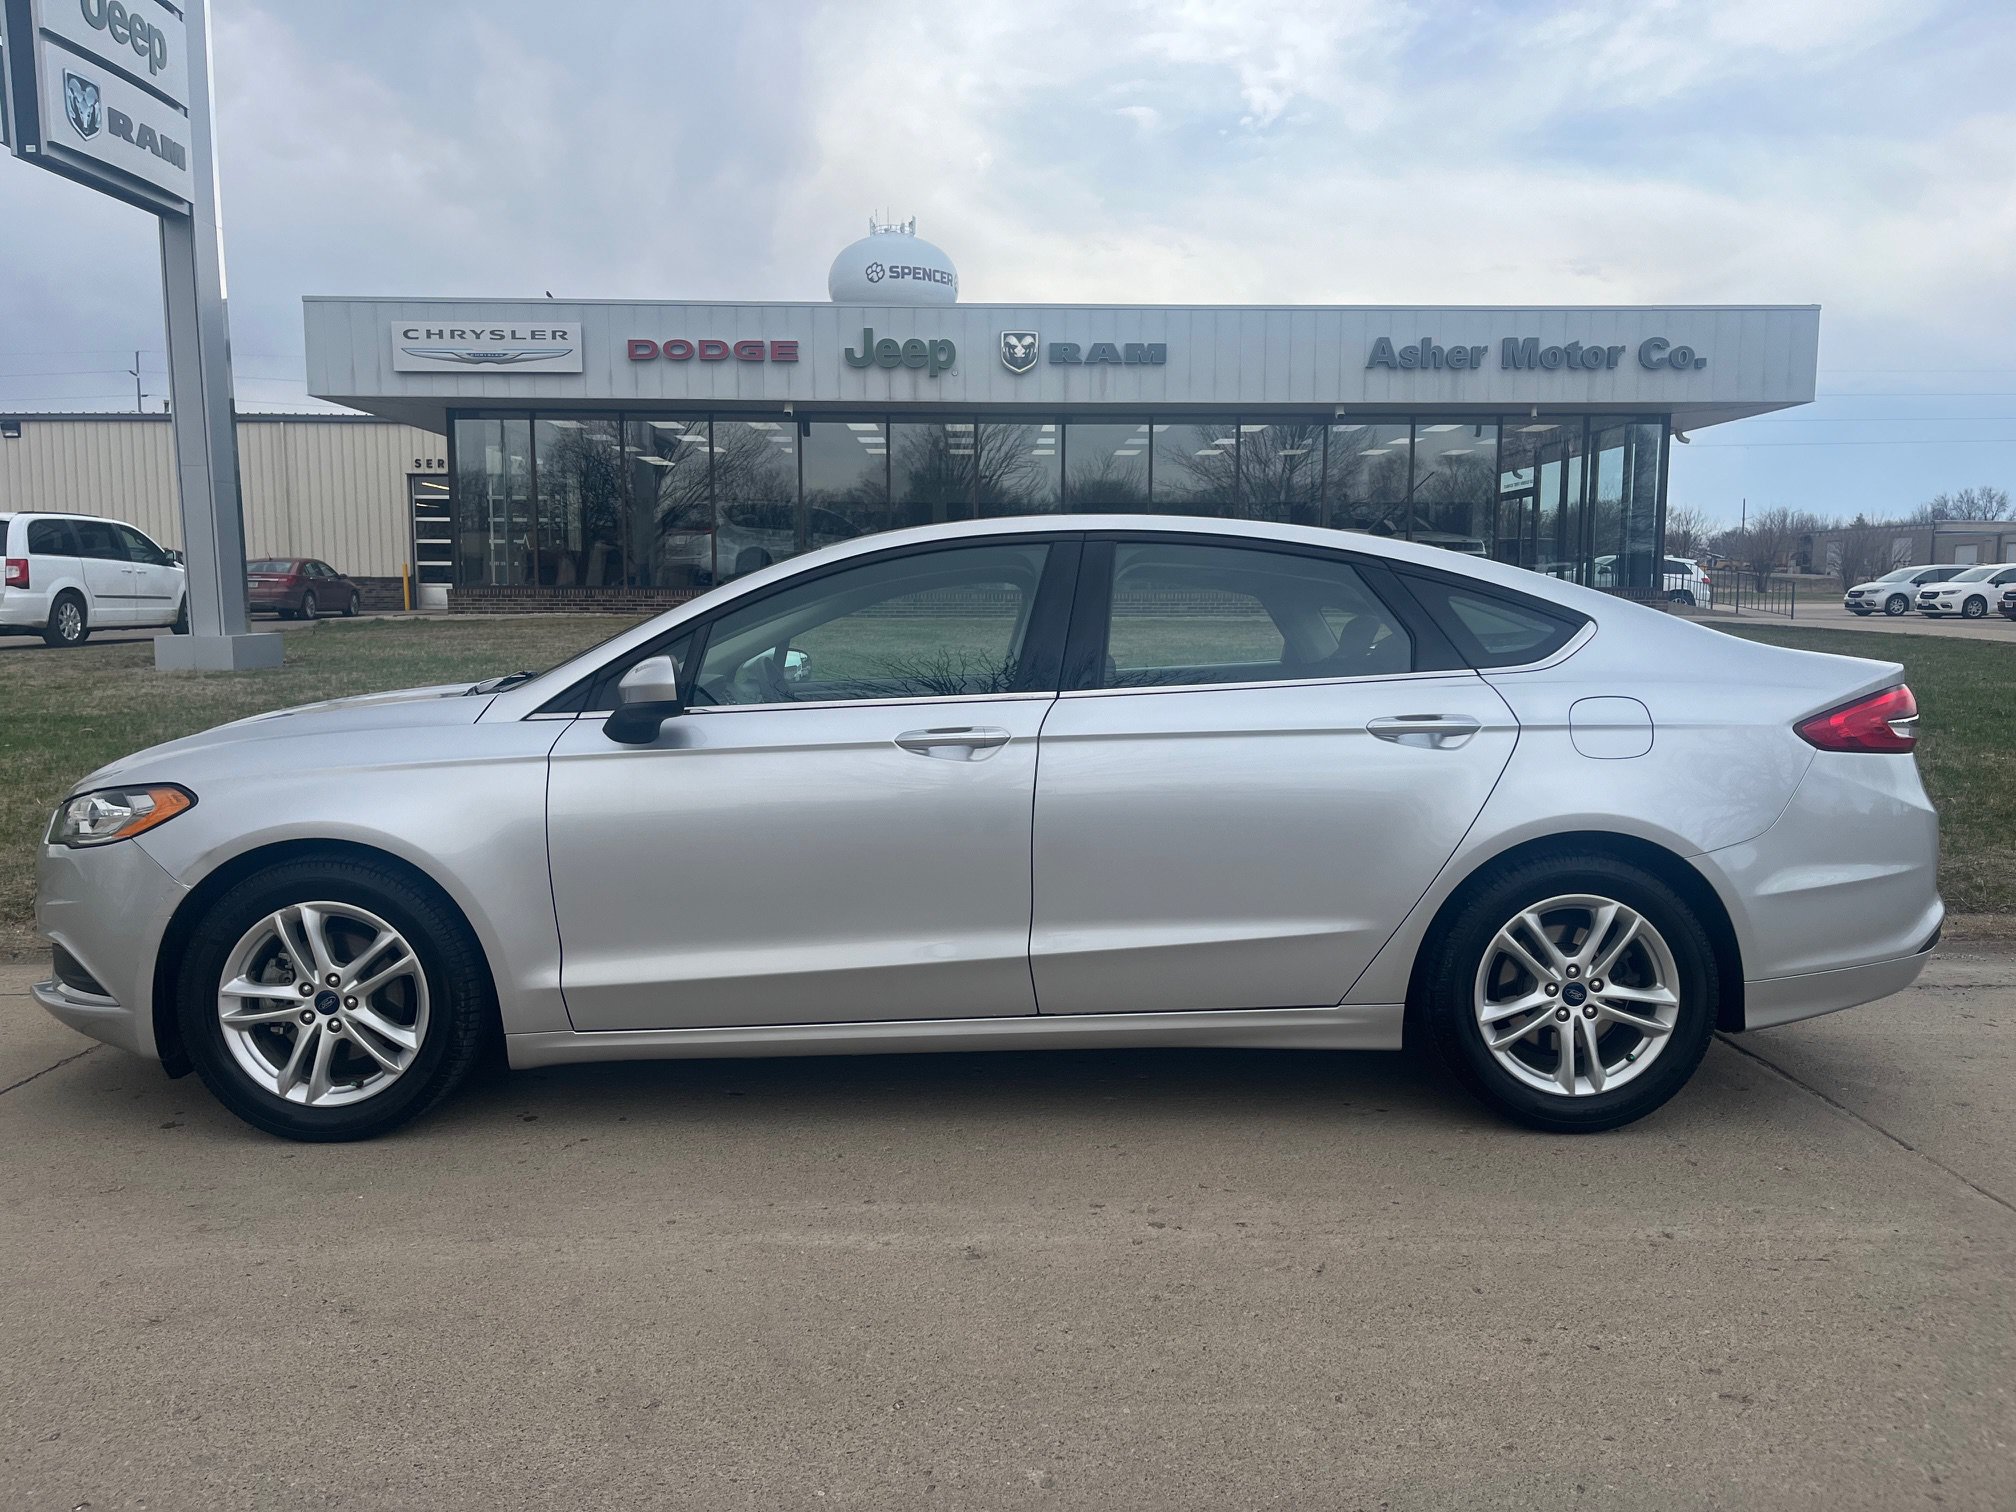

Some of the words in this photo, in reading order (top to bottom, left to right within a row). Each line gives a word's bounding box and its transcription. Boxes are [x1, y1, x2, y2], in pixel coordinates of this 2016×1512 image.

[107, 106, 186, 172] RAM
[888, 265, 953, 287] SPENCER
[402, 328, 568, 341] CHRYSLER
[628, 340, 799, 362] DODGE
[845, 328, 957, 377] Jeep
[1049, 342, 1167, 364] RAM
[1366, 336, 1488, 369] Asher
[1500, 336, 1626, 370] Motor
[1638, 336, 1707, 370] Co.
